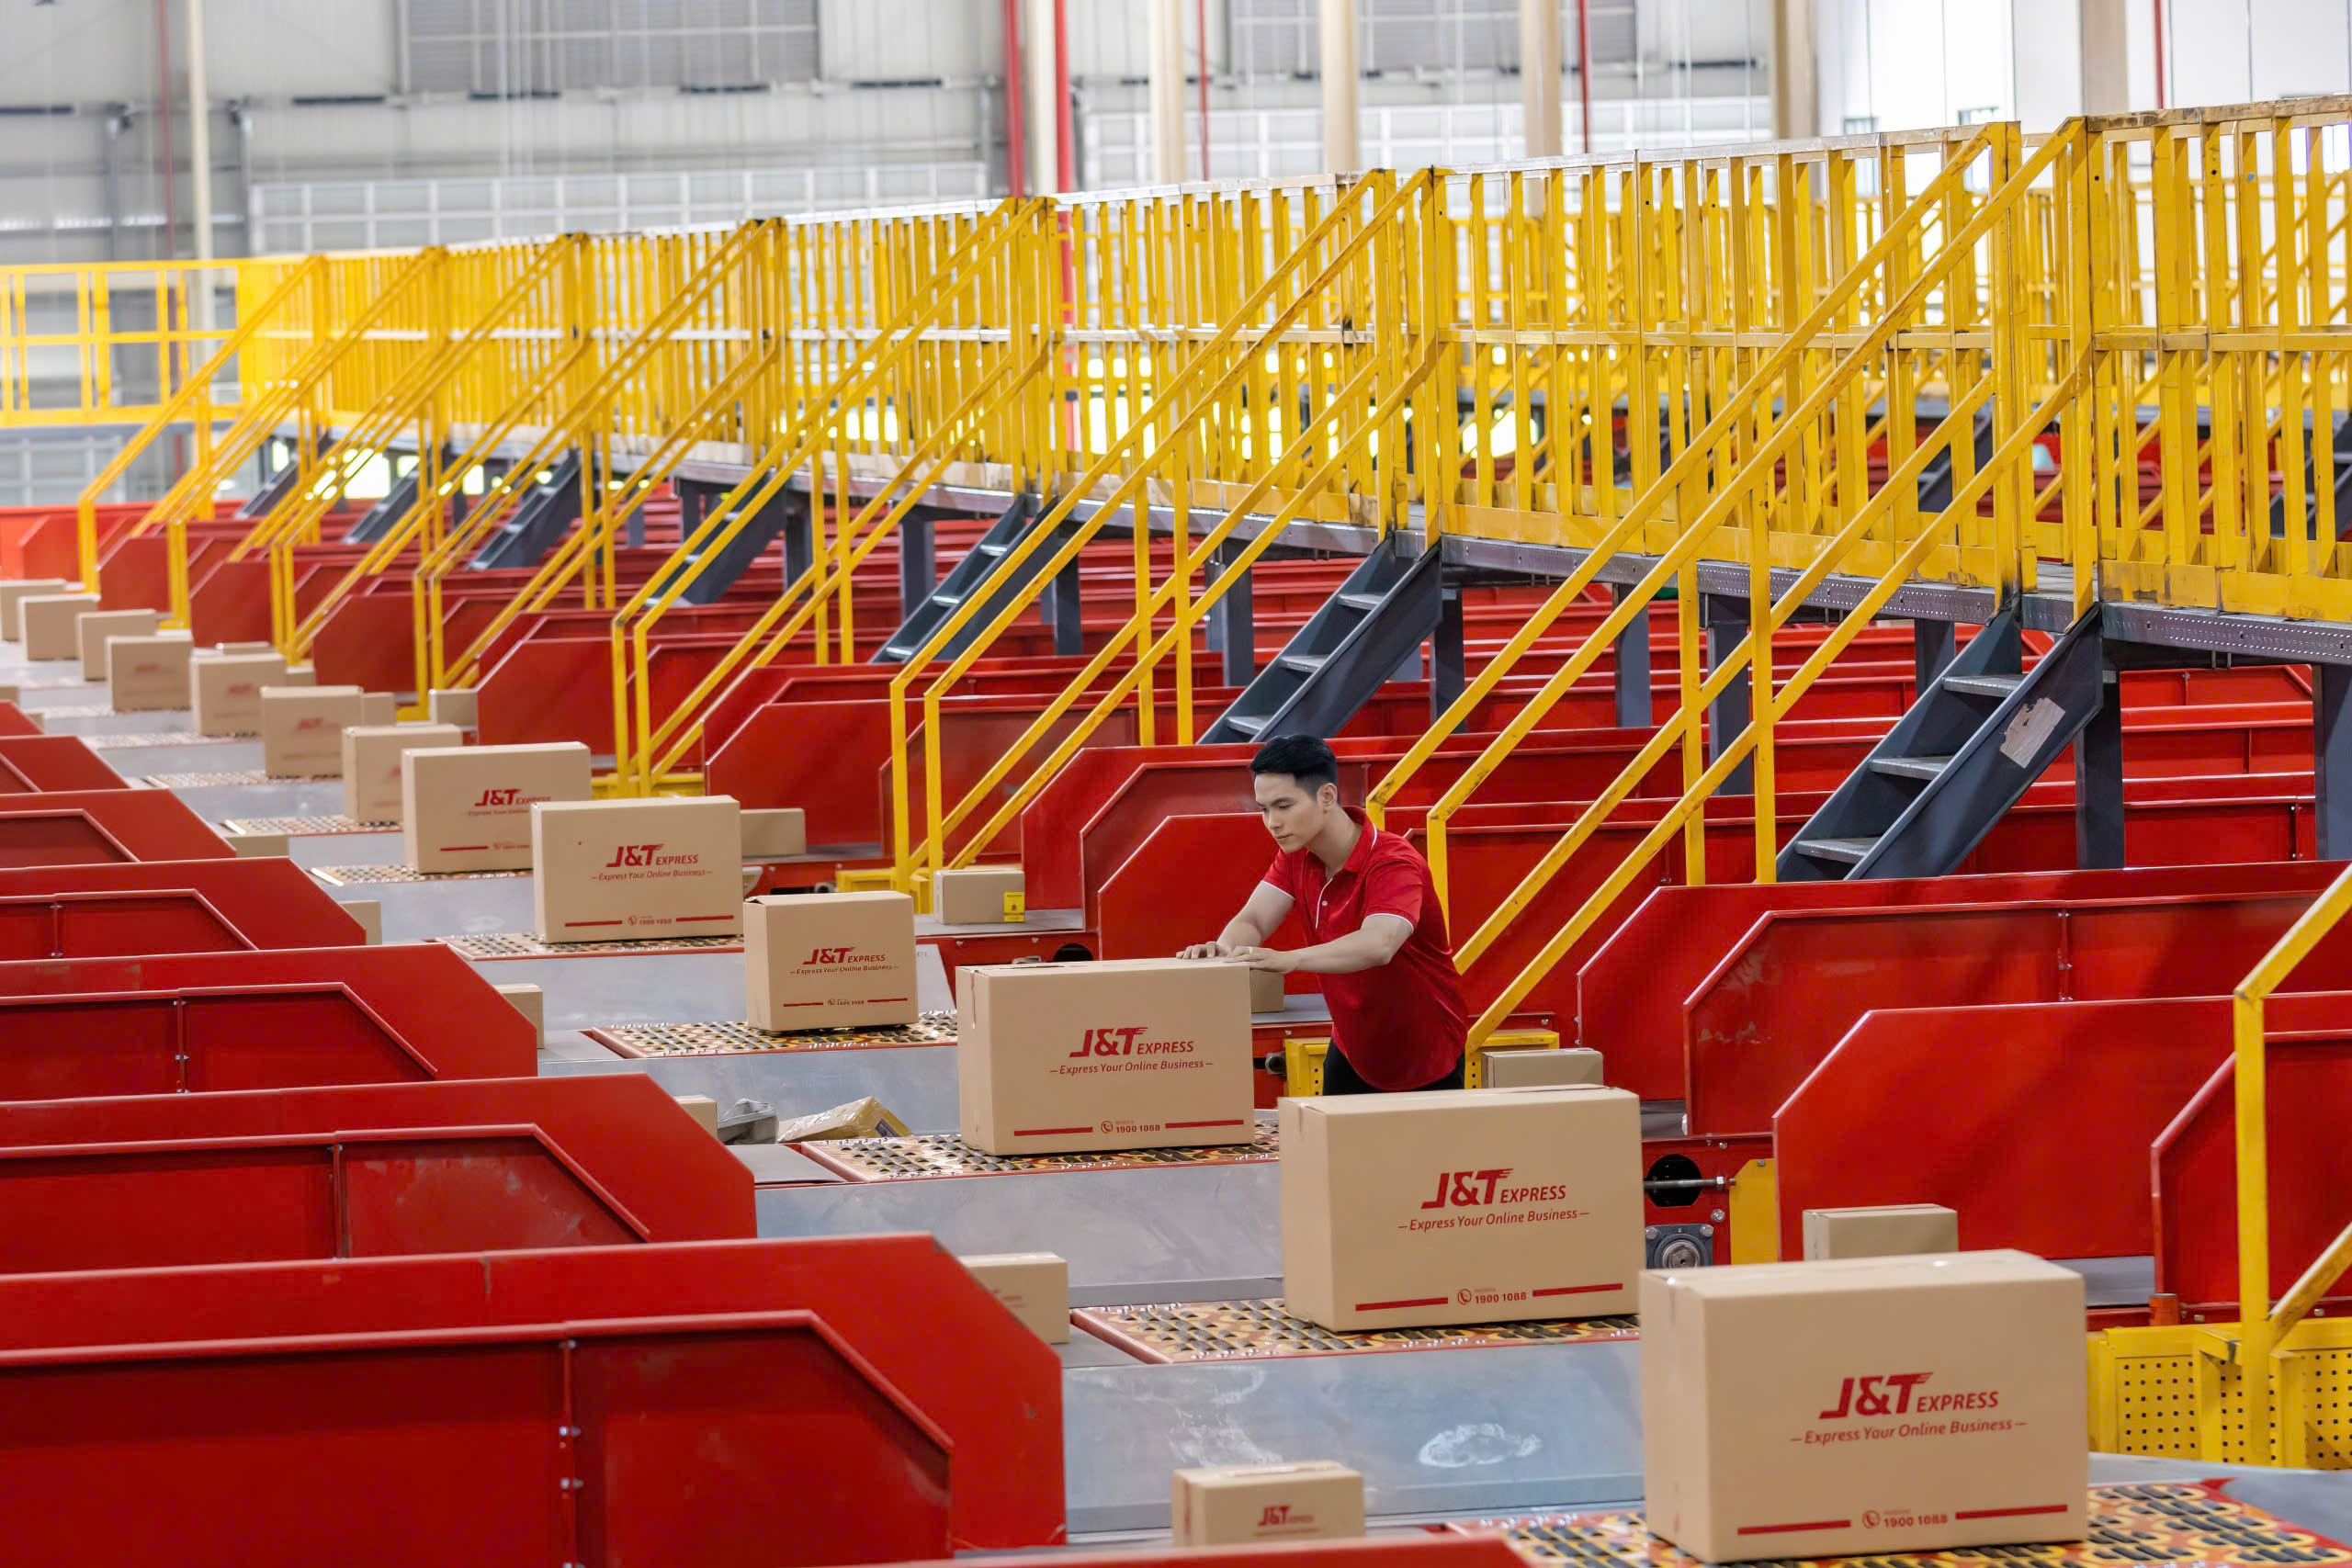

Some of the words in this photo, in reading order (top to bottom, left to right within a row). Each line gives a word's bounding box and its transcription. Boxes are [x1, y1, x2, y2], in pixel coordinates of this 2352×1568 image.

[605, 844, 664, 867] J&T
[655, 854, 698, 866] EXPRESS
[803, 947, 855, 964] J&T
[847, 954, 886, 964] EXPRESS
[1069, 1027, 1148, 1057] J&T
[1136, 1041, 1193, 1055] EXPRESS
[1059, 1065, 1098, 1077] Express
[1101, 1063, 1124, 1073] Your
[1125, 1060, 1158, 1072] Online
[1160, 1059, 1204, 1070] Business
[1115, 1125, 1137, 1134] 1900
[1139, 1123, 1160, 1133] 1088
[1420, 1168, 1514, 1209] J&T
[1499, 1185, 1566, 1204] EXPRESS
[1409, 1218, 1455, 1233] Express
[1457, 1215, 1484, 1227] Your
[1486, 1212, 1524, 1224] Online
[1527, 1208, 1577, 1223] Business
[1475, 1293, 1500, 1304] 1900
[1502, 1292, 1527, 1302] 1088
[1818, 1372, 1934, 1420] J&T
[1916, 1390, 1999, 1414] EXPRESS
[1804, 1429, 1860, 1446] Express
[1863, 1426, 1895, 1440] Your
[1898, 1421, 1947, 1438] Online
[1949, 1418, 2013, 1434] Business
[1883, 1517, 1915, 1529] 1900
